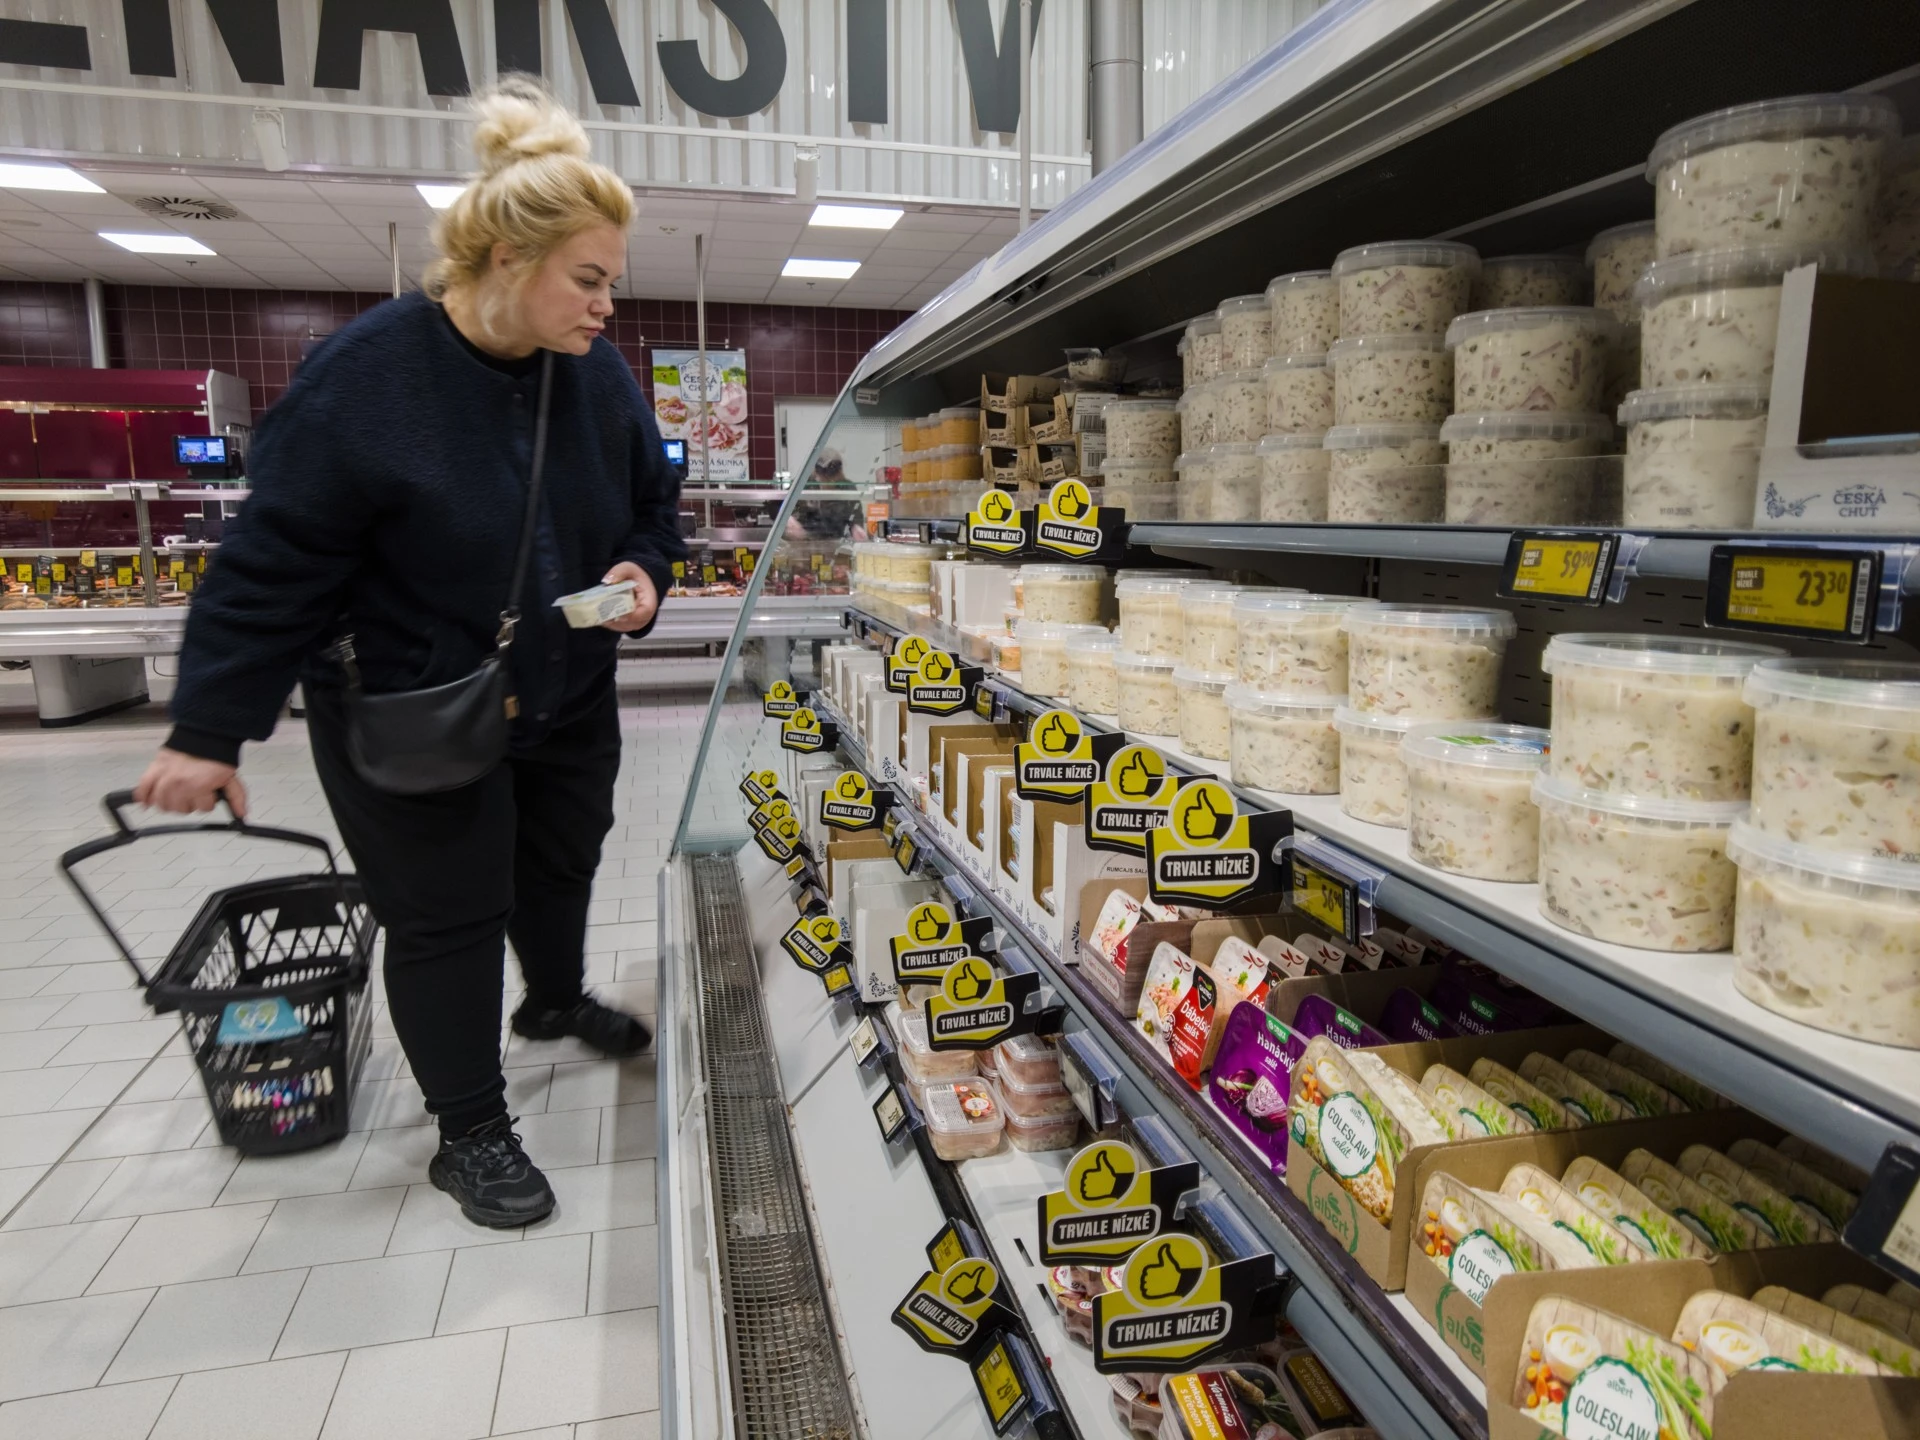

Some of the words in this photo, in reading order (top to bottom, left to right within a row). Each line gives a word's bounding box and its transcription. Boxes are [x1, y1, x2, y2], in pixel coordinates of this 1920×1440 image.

[1833, 489, 1887, 504] ČESKÁ
[1838, 503, 1879, 518] CHUŤ
[975, 529, 1000, 541] TRVALE
[1000, 528, 1021, 542] NÍZKÉ
[1044, 526, 1073, 540] TRVALE
[1074, 528, 1096, 544] NÍZKÉ
[916, 690, 940, 699] TRVALE
[942, 688, 960, 700] NÍZKÉ
[787, 734, 804, 742] TRVALE
[805, 734, 820, 744] NÍZKÉ
[1028, 766, 1064, 780] TRVALE
[1065, 764, 1092, 778] NÍZKÉ
[829, 806, 852, 815] TRVALE
[853, 806, 870, 818] NÍZKÉ
[1101, 812, 1142, 828] TRVALE
[1106, 866, 1133, 874] RUMCAJS
[1166, 860, 1212, 878] TRVALE
[1214, 856, 1250, 876] NÍZKÉ
[793, 933, 813, 952] TRVALE
[809, 945, 828, 964] NÍZKÉ
[904, 953, 938, 967] TRVALE
[939, 949, 965, 964] NÍZKÉ
[940, 1016, 977, 1031] TRVALE
[978, 1008, 1006, 1026] NÍZKÉ
[1180, 1000, 1210, 1040] Ďábelský
[1184, 1023, 1200, 1040] salát
[1257, 1032, 1295, 1074] Hanácký
[1264, 1056, 1278, 1071] salát
[1328, 1107, 1371, 1160] COLESLAW
[1332, 1136, 1350, 1160] salát
[1058, 1219, 1109, 1241] TRVALE
[1112, 1212, 1150, 1232] NÍZKÉ
[1314, 1194, 1350, 1239] albert
[1482, 1247, 1503, 1268] albert
[914, 1297, 946, 1324] TRVALE
[941, 1314, 970, 1338] NÍZKÉ
[1116, 1319, 1172, 1343] TRVALE
[1176, 1310, 1220, 1336] NÍZKÉ
[1606, 1378, 1634, 1398] albert
[1183, 1395, 1204, 1428] křenem
[1186, 1376, 1206, 1410] Šunkový
[1200, 1407, 1220, 1438] závitek
[1575, 1394, 1651, 1440] COLESLAW
